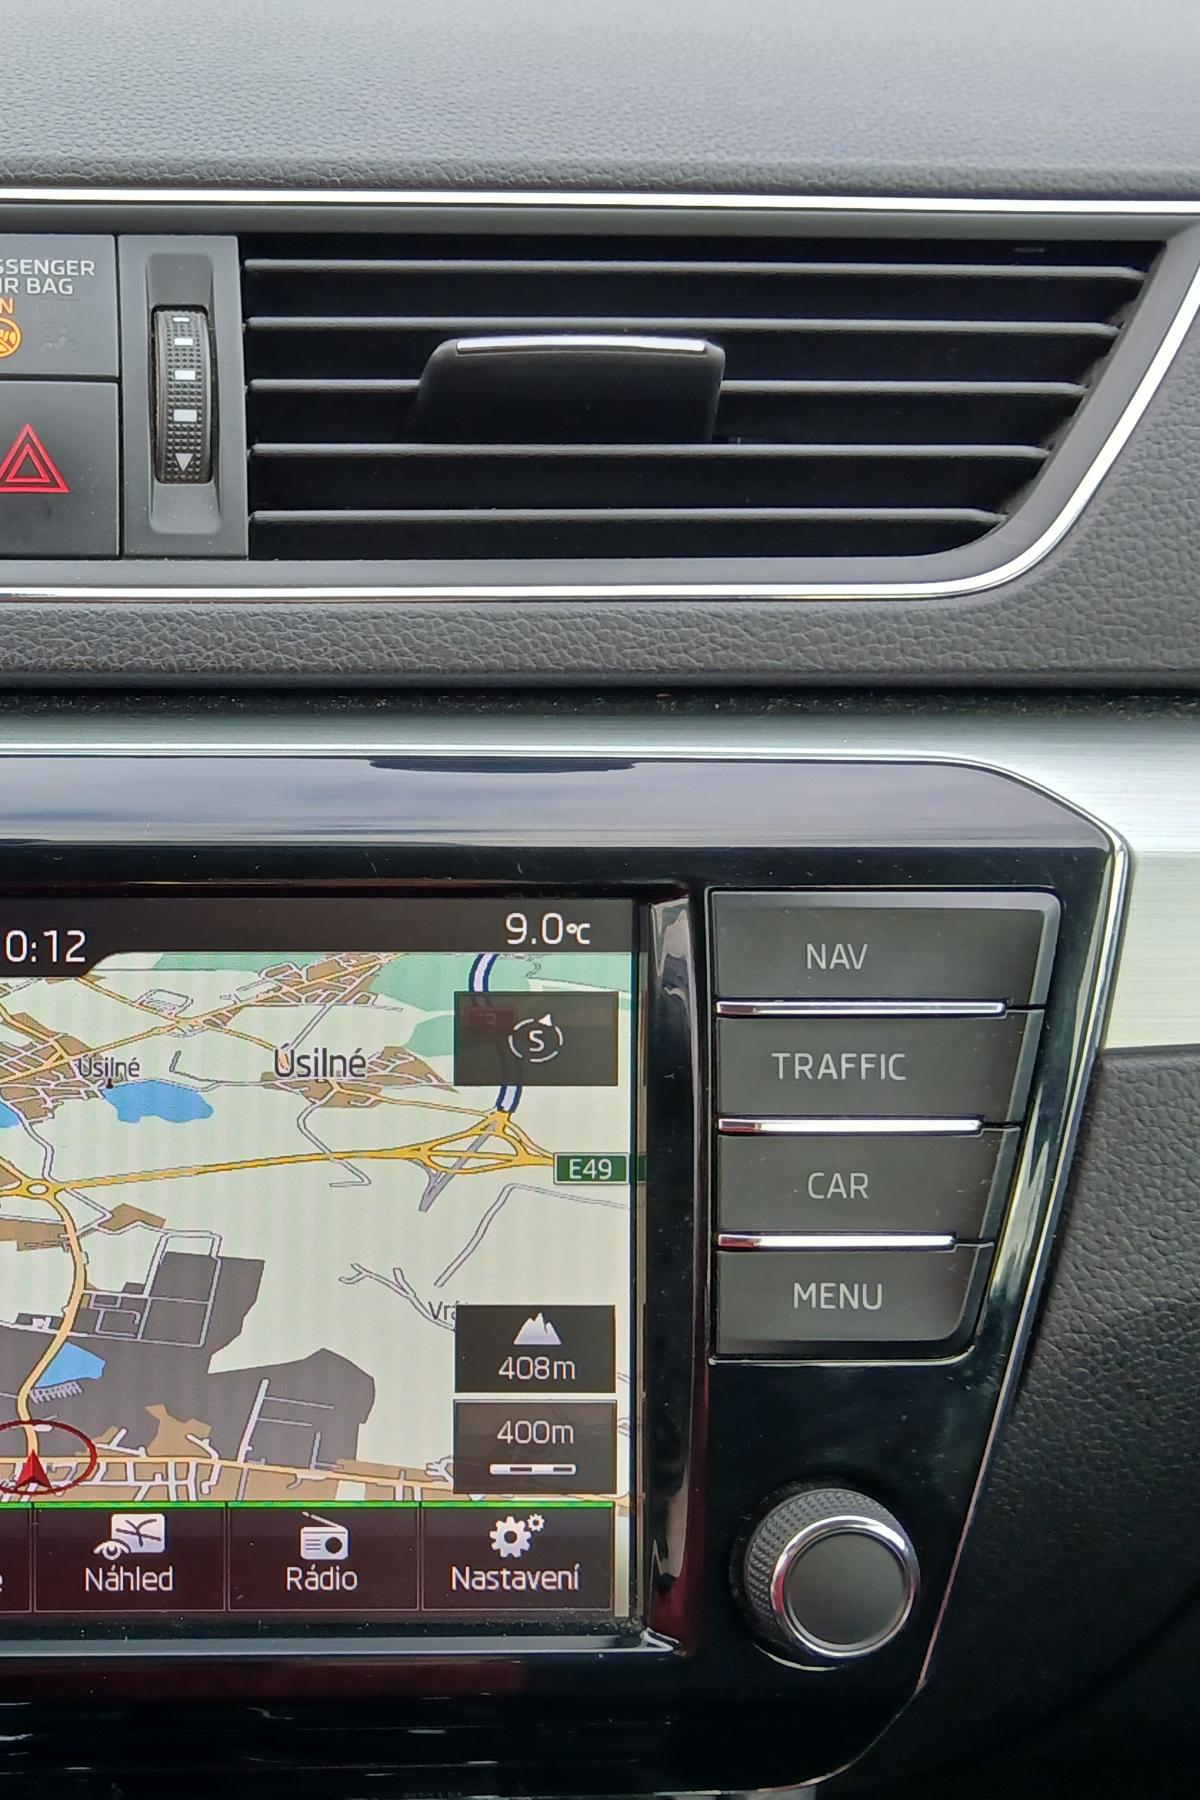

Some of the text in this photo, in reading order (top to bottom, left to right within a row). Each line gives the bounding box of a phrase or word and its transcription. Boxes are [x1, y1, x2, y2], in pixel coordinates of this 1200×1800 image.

[26, 277, 74, 295] BAG
[805, 944, 869, 970] NAV
[528, 1029, 545, 1052] S
[274, 1044, 366, 1078] Úsilné
[771, 1052, 907, 1081] TRAFFIC
[569, 1159, 613, 1180] E49
[806, 1171, 869, 1200] CAR
[793, 1283, 884, 1310] MENU
[498, 1356, 576, 1380] 408m
[496, 1420, 574, 1444] 400m
[84, 1564, 173, 1592] Náhled
[286, 1563, 358, 1591] Rádio
[451, 1563, 579, 1592] Nastavení
